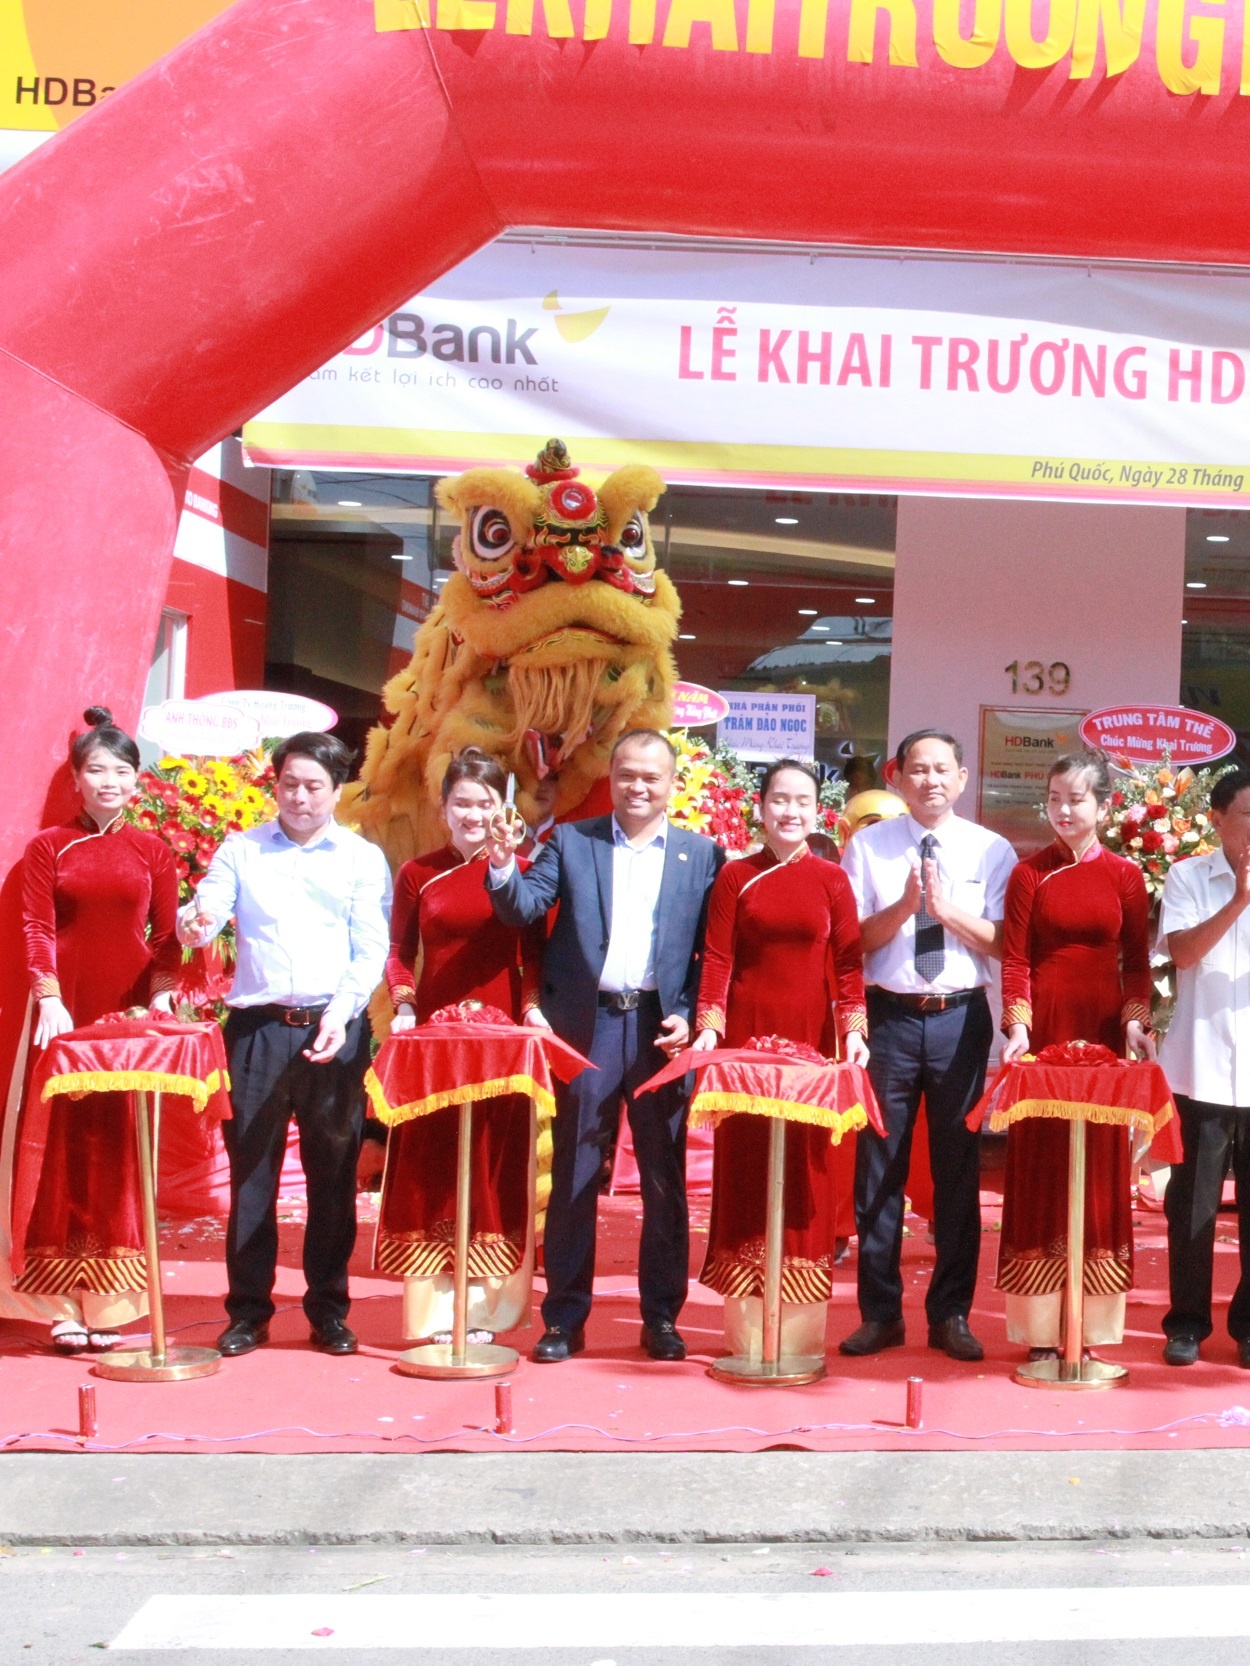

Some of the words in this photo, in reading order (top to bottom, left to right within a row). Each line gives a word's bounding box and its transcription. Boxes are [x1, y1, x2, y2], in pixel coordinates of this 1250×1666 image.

[679, 306, 738, 381] LỄ
[757, 328, 892, 388] KHAI
[911, 332, 1147, 400] TRƯƠNG
[349, 366, 381, 384] kết
[393, 368, 417, 388] lợi
[468, 376, 503, 390] cao
[514, 375, 559, 393] nhất
[1031, 461, 1065, 480] Phú
[1068, 461, 1114, 484] Quốc,
[1119, 465, 1163, 487] Ngày
[1166, 468, 1188, 485] 28
[1192, 468, 1245, 492] Tháng
[1004, 660, 1071, 697] 139
[1092, 713, 1143, 731] TRUNG
[1147, 711, 1180, 729] TÂM
[1185, 718, 1215, 739] THẺ
[1004, 735, 1055, 749] HDBank
[1101, 734, 1124, 747] Chúc
[1127, 735, 1153, 750] Mừng
[1156, 737, 1177, 750] Khai
[1180, 739, 1213, 755] Trương
